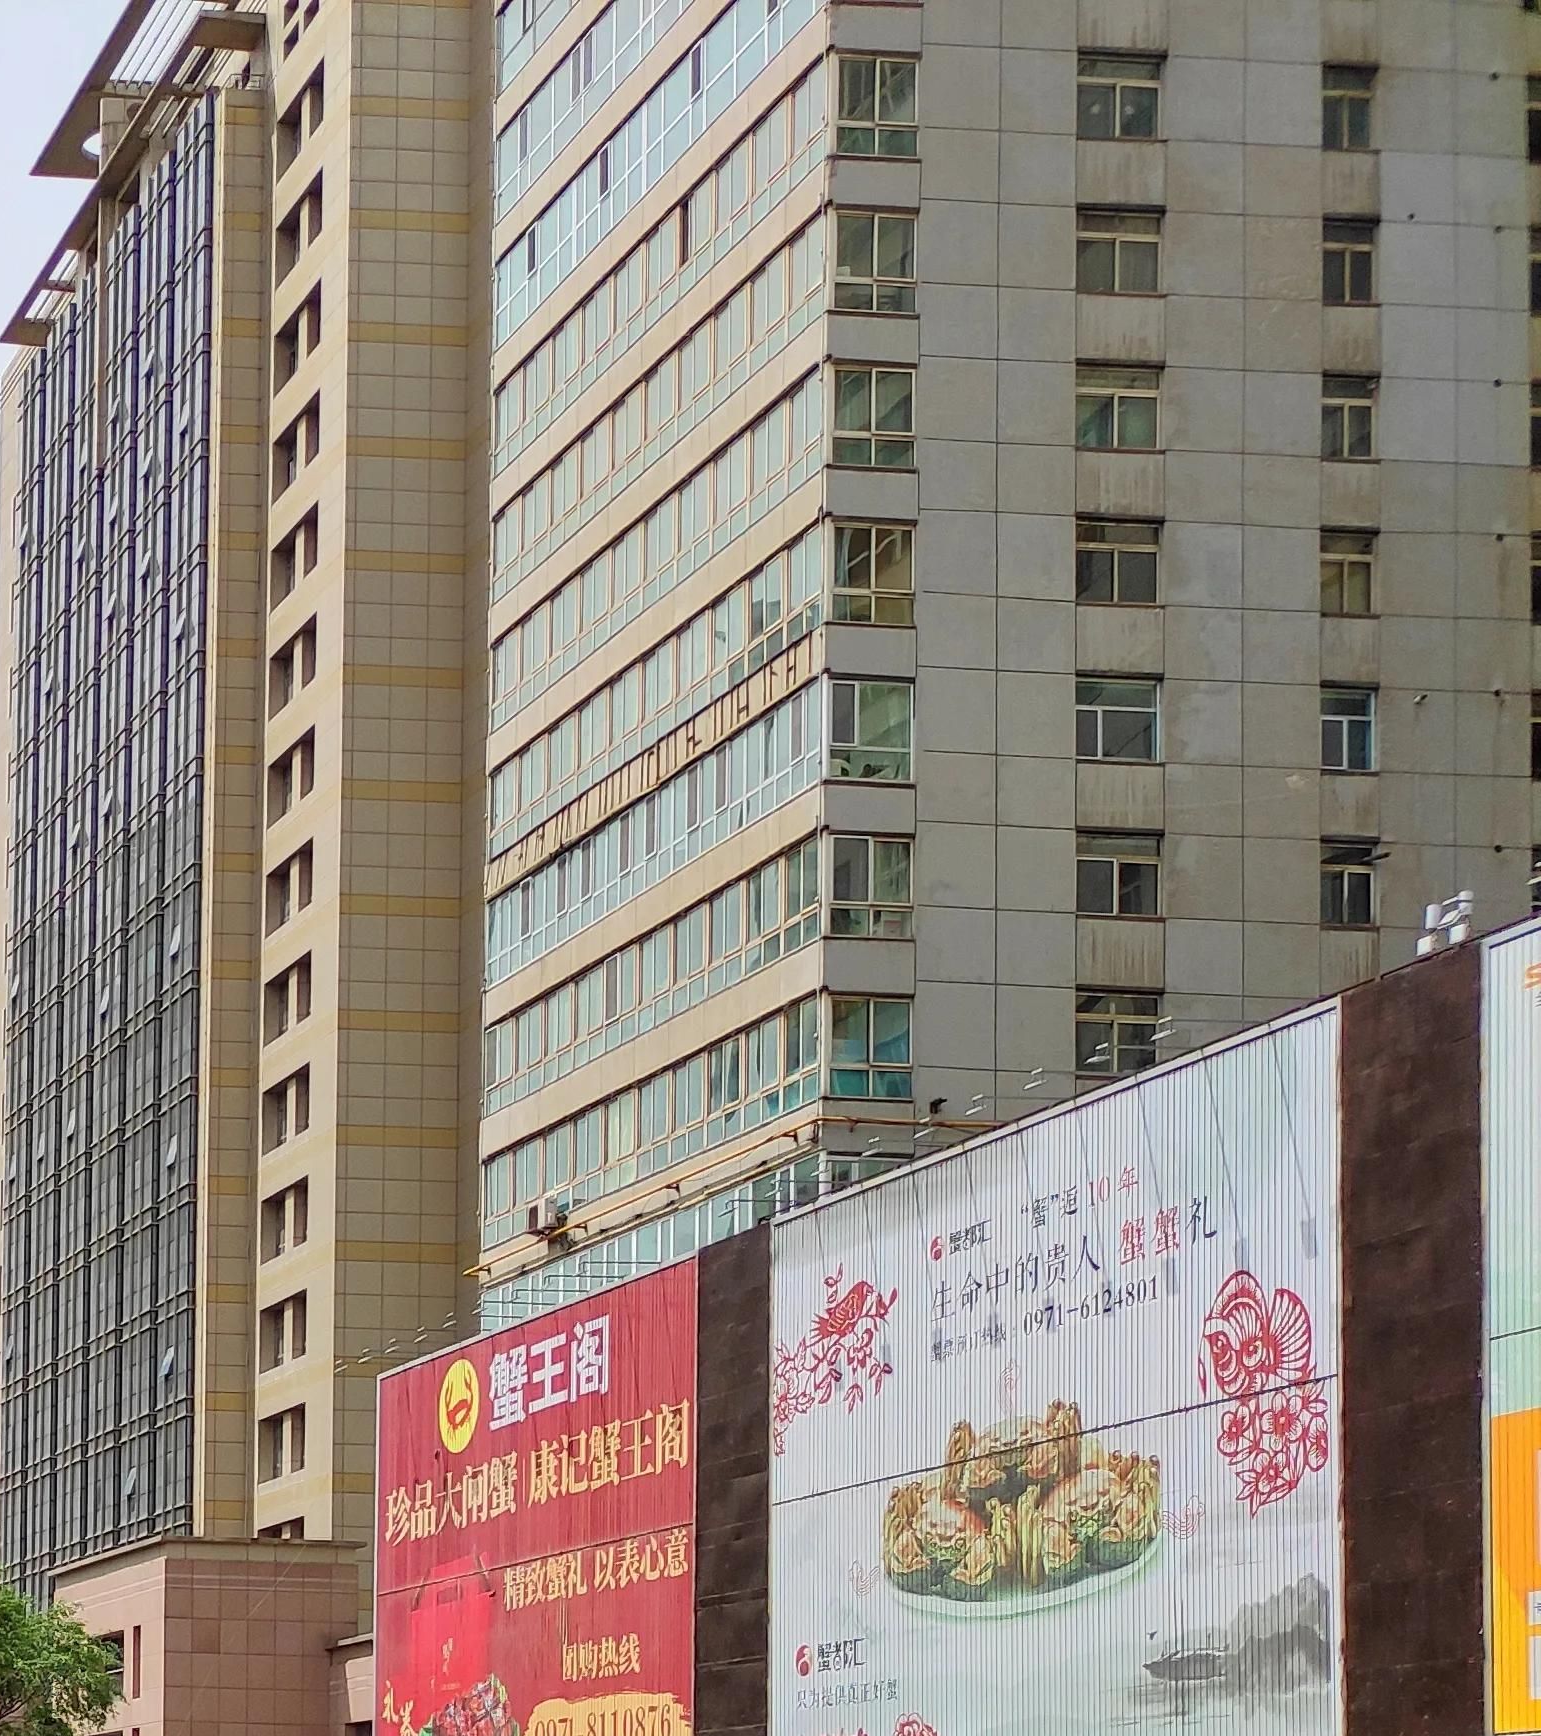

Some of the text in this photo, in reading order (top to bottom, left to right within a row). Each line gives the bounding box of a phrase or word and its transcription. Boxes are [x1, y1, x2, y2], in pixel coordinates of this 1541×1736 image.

[931, 1235, 1100, 1321] 生命中的贵人
[1024, 1275, 1158, 1336] 0971-6124801
[489, 1314, 610, 1431] 蟹王阁
[385, 1398, 690, 1547] 珍品大闸蟹 康记蟹王阁
[503, 1526, 689, 1611] 精致蟹礼 以表心意
[562, 1633, 641, 1681] 团购热线
[817, 1637, 868, 1673] 蟹都汇
